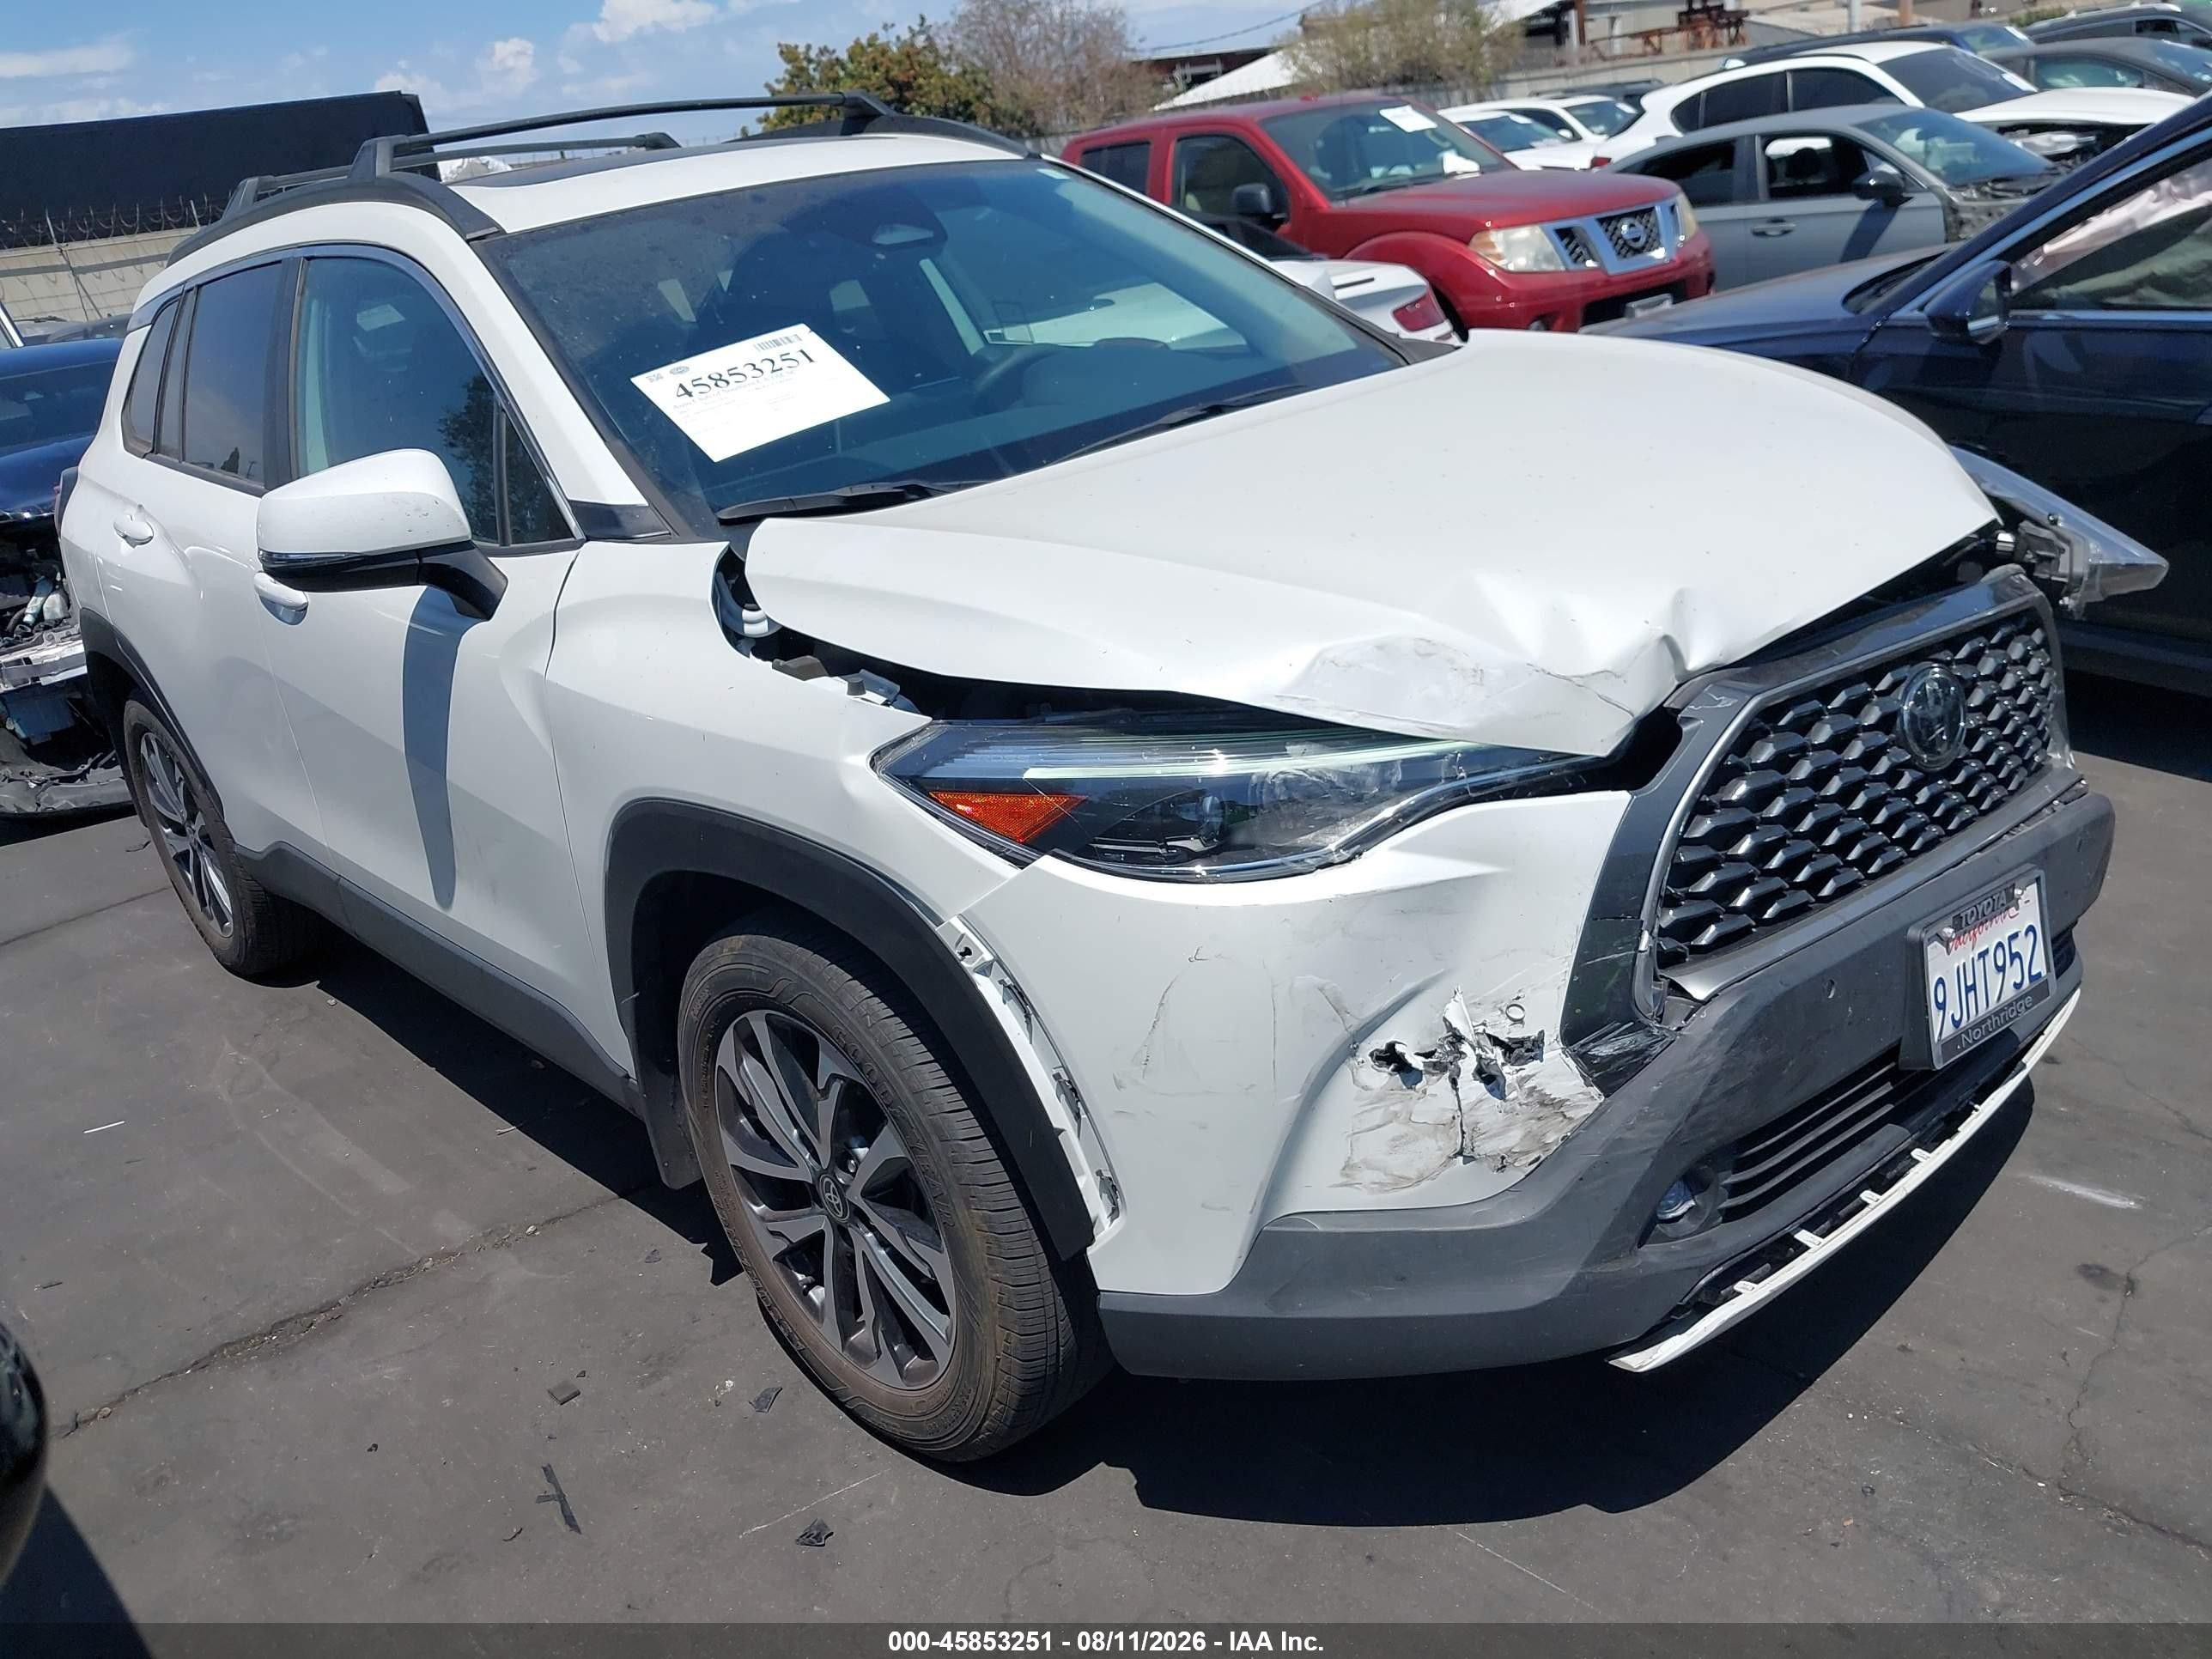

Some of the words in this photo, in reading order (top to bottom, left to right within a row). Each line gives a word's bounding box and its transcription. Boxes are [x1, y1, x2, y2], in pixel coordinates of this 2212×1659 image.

[675, 349, 817, 398] 45853251
[1960, 891, 2007, 927] TOYOTA
[1933, 923, 2044, 1041] 9JHT952
[1961, 995, 2033, 1047] Northridge
